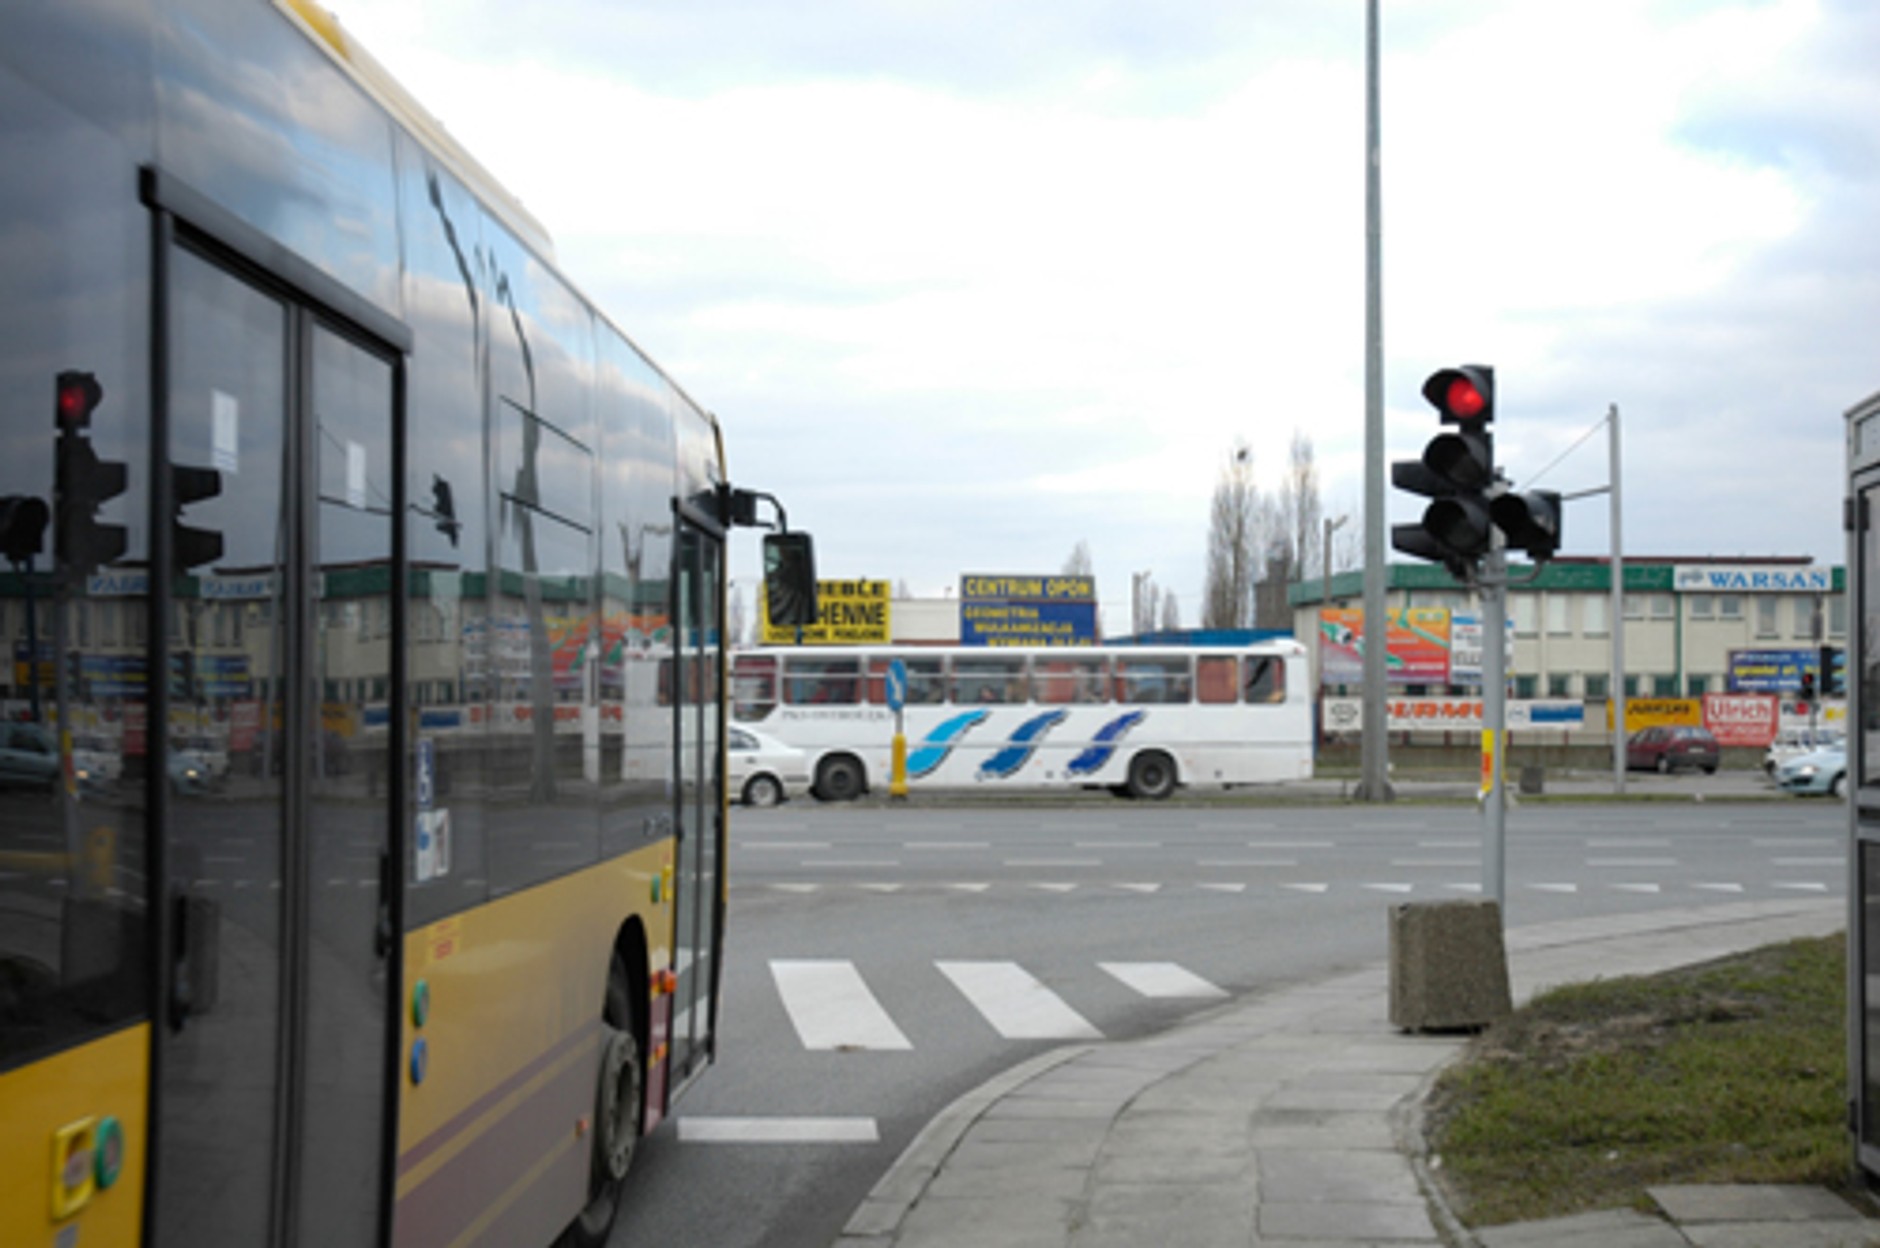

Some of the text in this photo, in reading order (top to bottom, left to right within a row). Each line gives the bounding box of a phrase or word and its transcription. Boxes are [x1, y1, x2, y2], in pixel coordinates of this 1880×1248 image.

[966, 577, 1089, 597] CENTRUM OPON
[1708, 571, 1828, 588] WARSAN
[818, 601, 886, 625] HENNE
[1709, 700, 1770, 723] Ulrich
